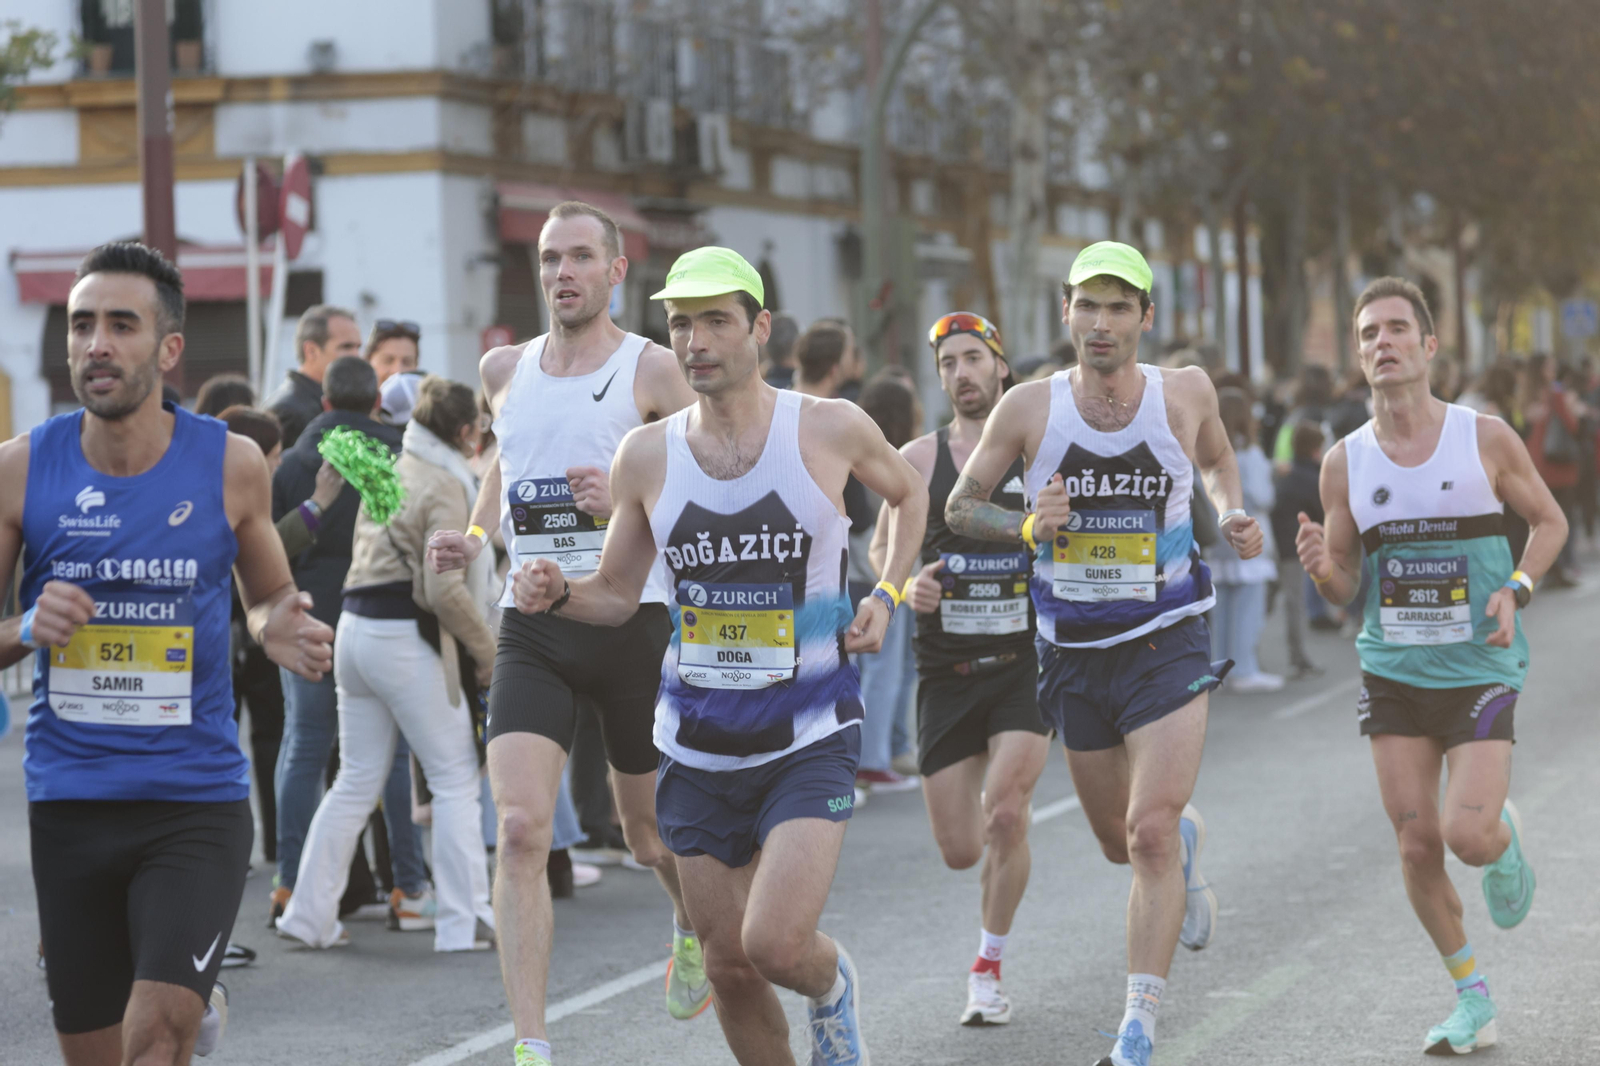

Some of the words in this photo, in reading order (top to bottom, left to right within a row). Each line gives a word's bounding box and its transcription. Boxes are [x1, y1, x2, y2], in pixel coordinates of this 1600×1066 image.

[540, 483, 574, 497] ZUR
[1051, 468, 1168, 500] OĞAZİÇİ
[543, 512, 578, 529] 2560
[1085, 517, 1143, 529] ZURICH
[1378, 522, 1415, 537] Peñota
[1418, 520, 1457, 534] Dental
[553, 536, 576, 548] BAS
[664, 523, 804, 570] BOĞAZİÇİ
[1090, 545, 1116, 559] 428
[968, 557, 1019, 571] ZURICH
[1406, 561, 1457, 575] ZURICH
[1085, 568, 1122, 579] GUNES
[968, 583, 1001, 597] 2550
[1408, 588, 1439, 603] 2612
[711, 591, 778, 605] ZURICH
[94, 601, 175, 620] ZURICH
[1397, 610, 1454, 622] CARRASCAL
[719, 624, 747, 640] 437
[100, 642, 134, 662] 521
[717, 650, 753, 663] DOGA
[92, 675, 144, 692] SAMIR
